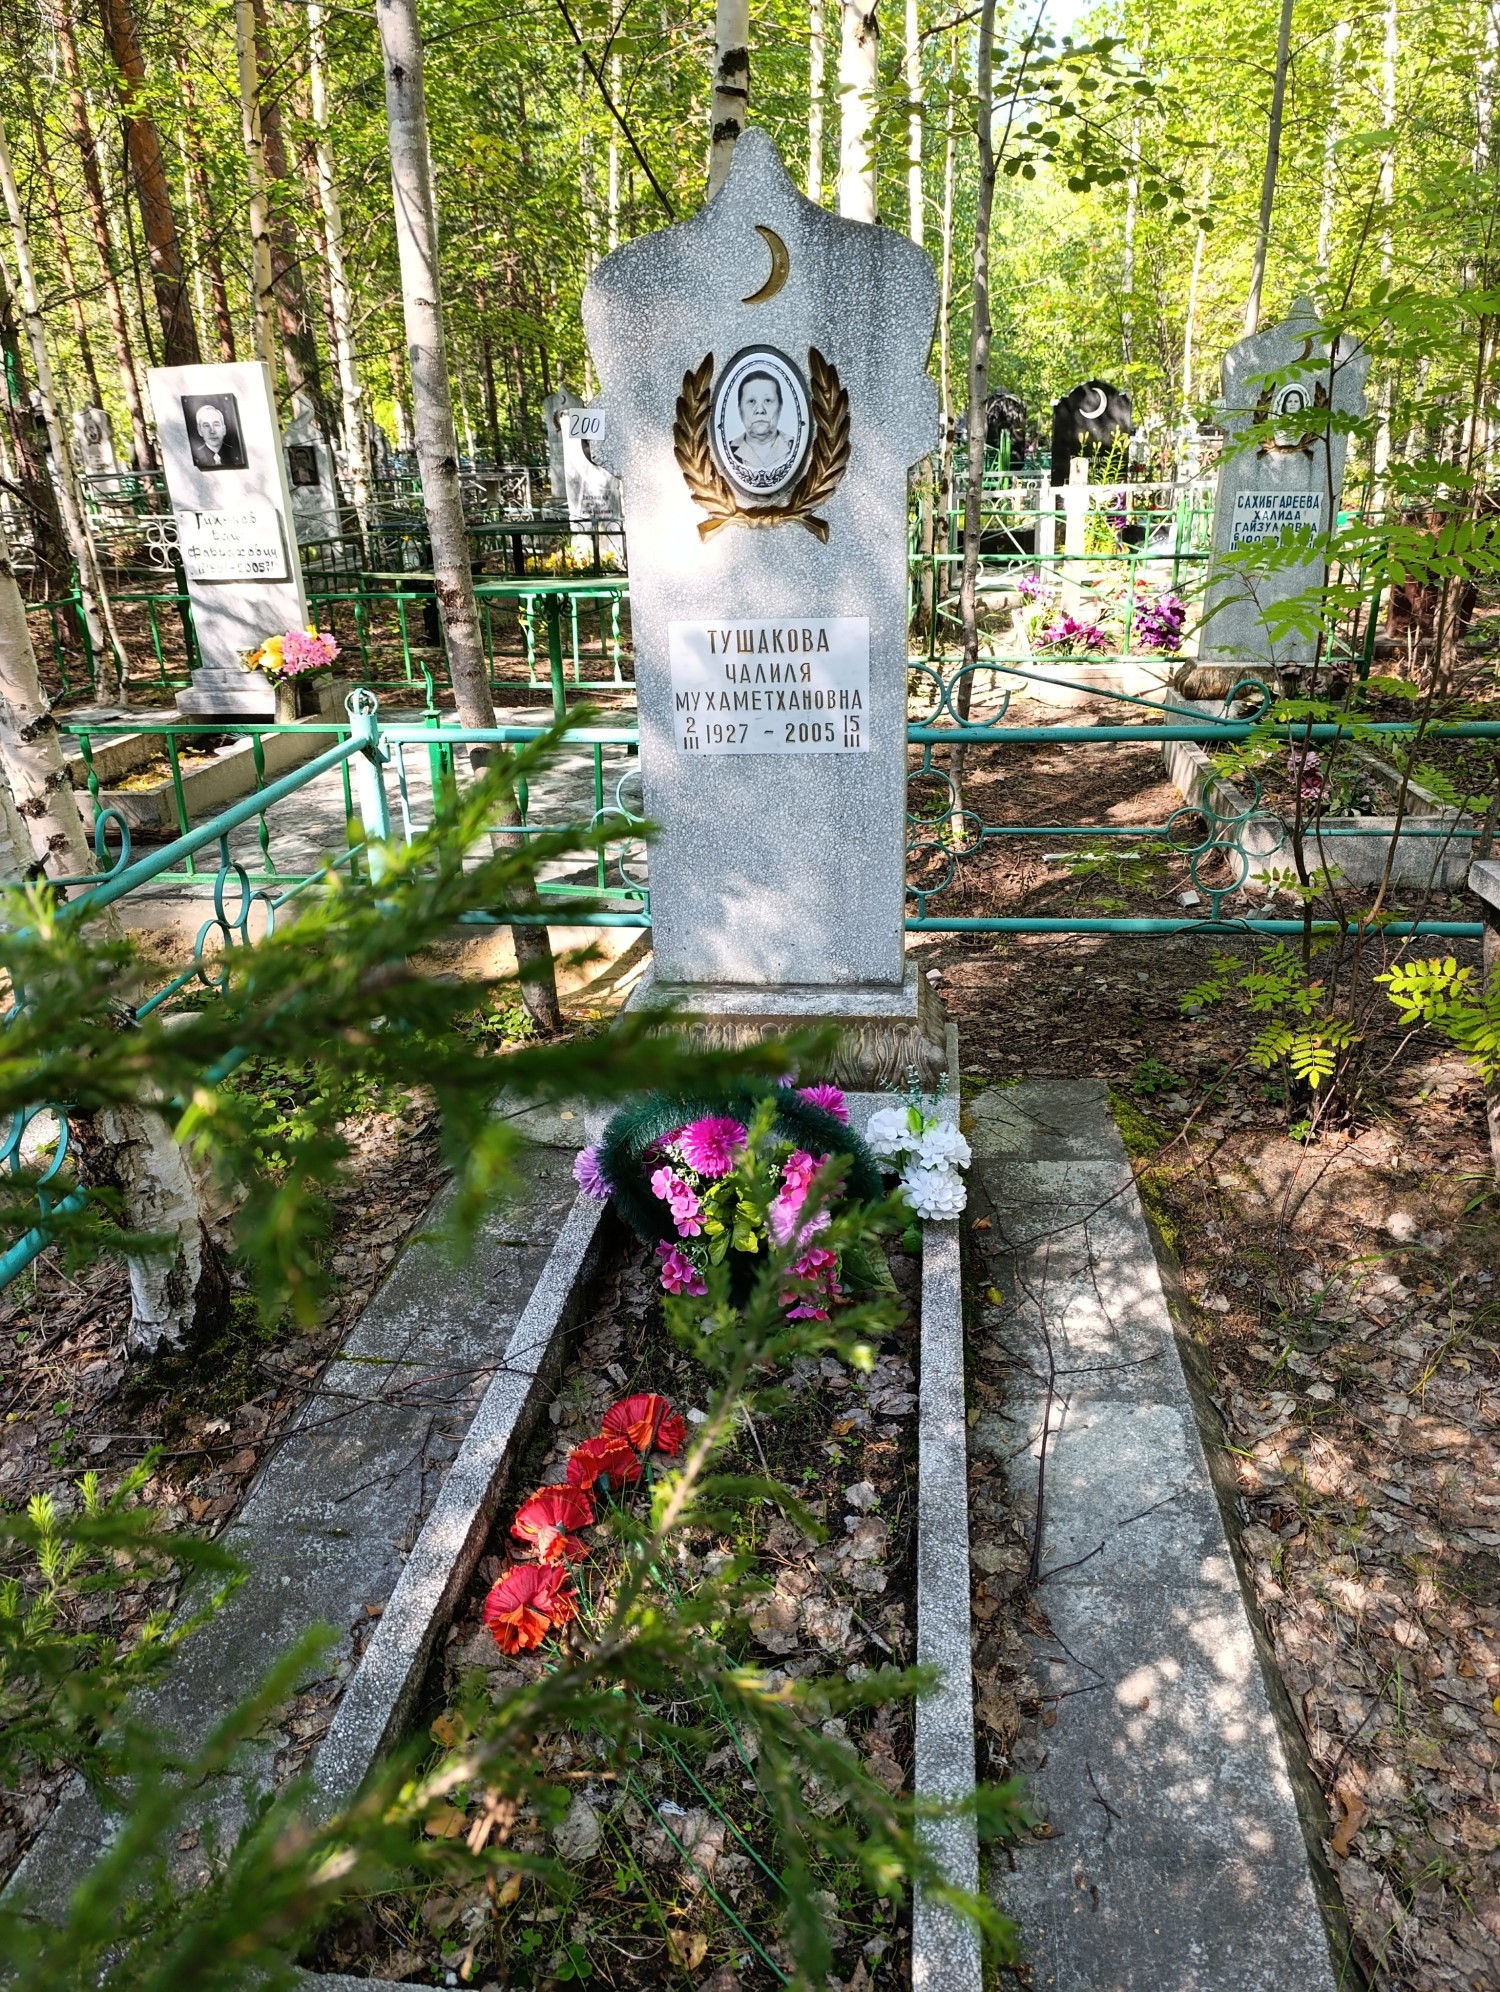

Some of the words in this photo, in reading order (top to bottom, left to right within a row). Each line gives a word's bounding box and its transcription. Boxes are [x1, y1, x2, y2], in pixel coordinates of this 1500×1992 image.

[570, 414, 600, 436] 200
[1237, 494, 1320, 509] САХИБГАРЕЕВА
[1254, 511, 1301, 521] ХАЛИДА
[707, 628, 830, 654] ТУШАКОВА
[725, 662, 812, 684] ЧАЛИЛЯ
[675, 689, 863, 711] МУХАМЕТХАНОВНА
[686, 716, 696, 734] 2
[706, 723, 748, 744] 1927
[785, 722, 835, 743] 2005
[844, 715, 860, 733] 15
[683, 737, 700, 750] III
[843, 734, 860, 748] III
